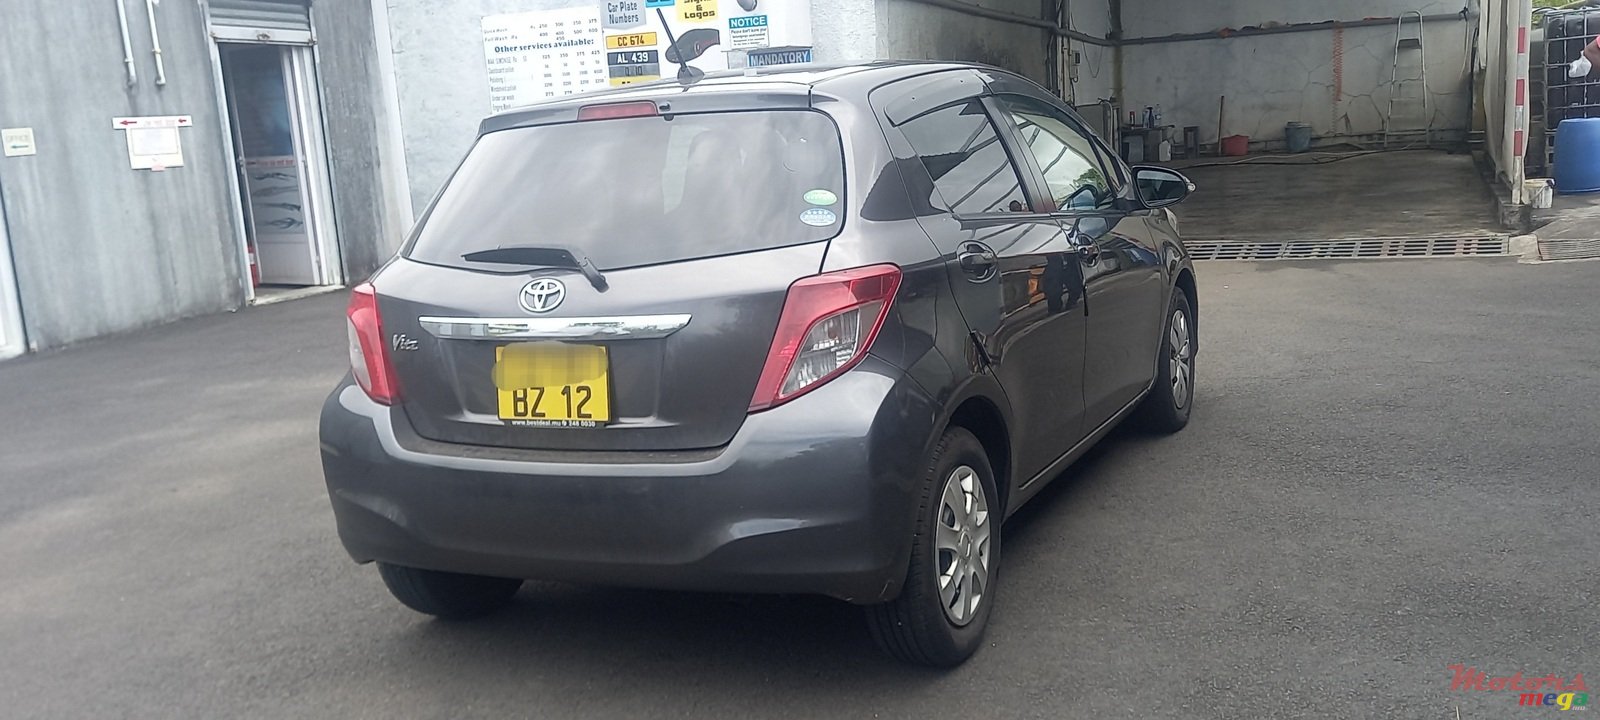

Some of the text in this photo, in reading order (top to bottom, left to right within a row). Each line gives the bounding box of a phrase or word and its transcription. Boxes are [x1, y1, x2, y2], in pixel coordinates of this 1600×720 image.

[607, 1, 637, 12] Car Plate
[609, 14, 638, 24] Numbers
[684, 10, 715, 19] Logos
[730, 16, 766, 27] NOTICE
[494, 38, 594, 53] Other services available:
[617, 35, 644, 46] CC 674
[617, 52, 648, 63] AL 439
[750, 51, 808, 66] MANDATORY
[392, 333, 419, 351] Vitz
[512, 385, 592, 418] BZ 12
